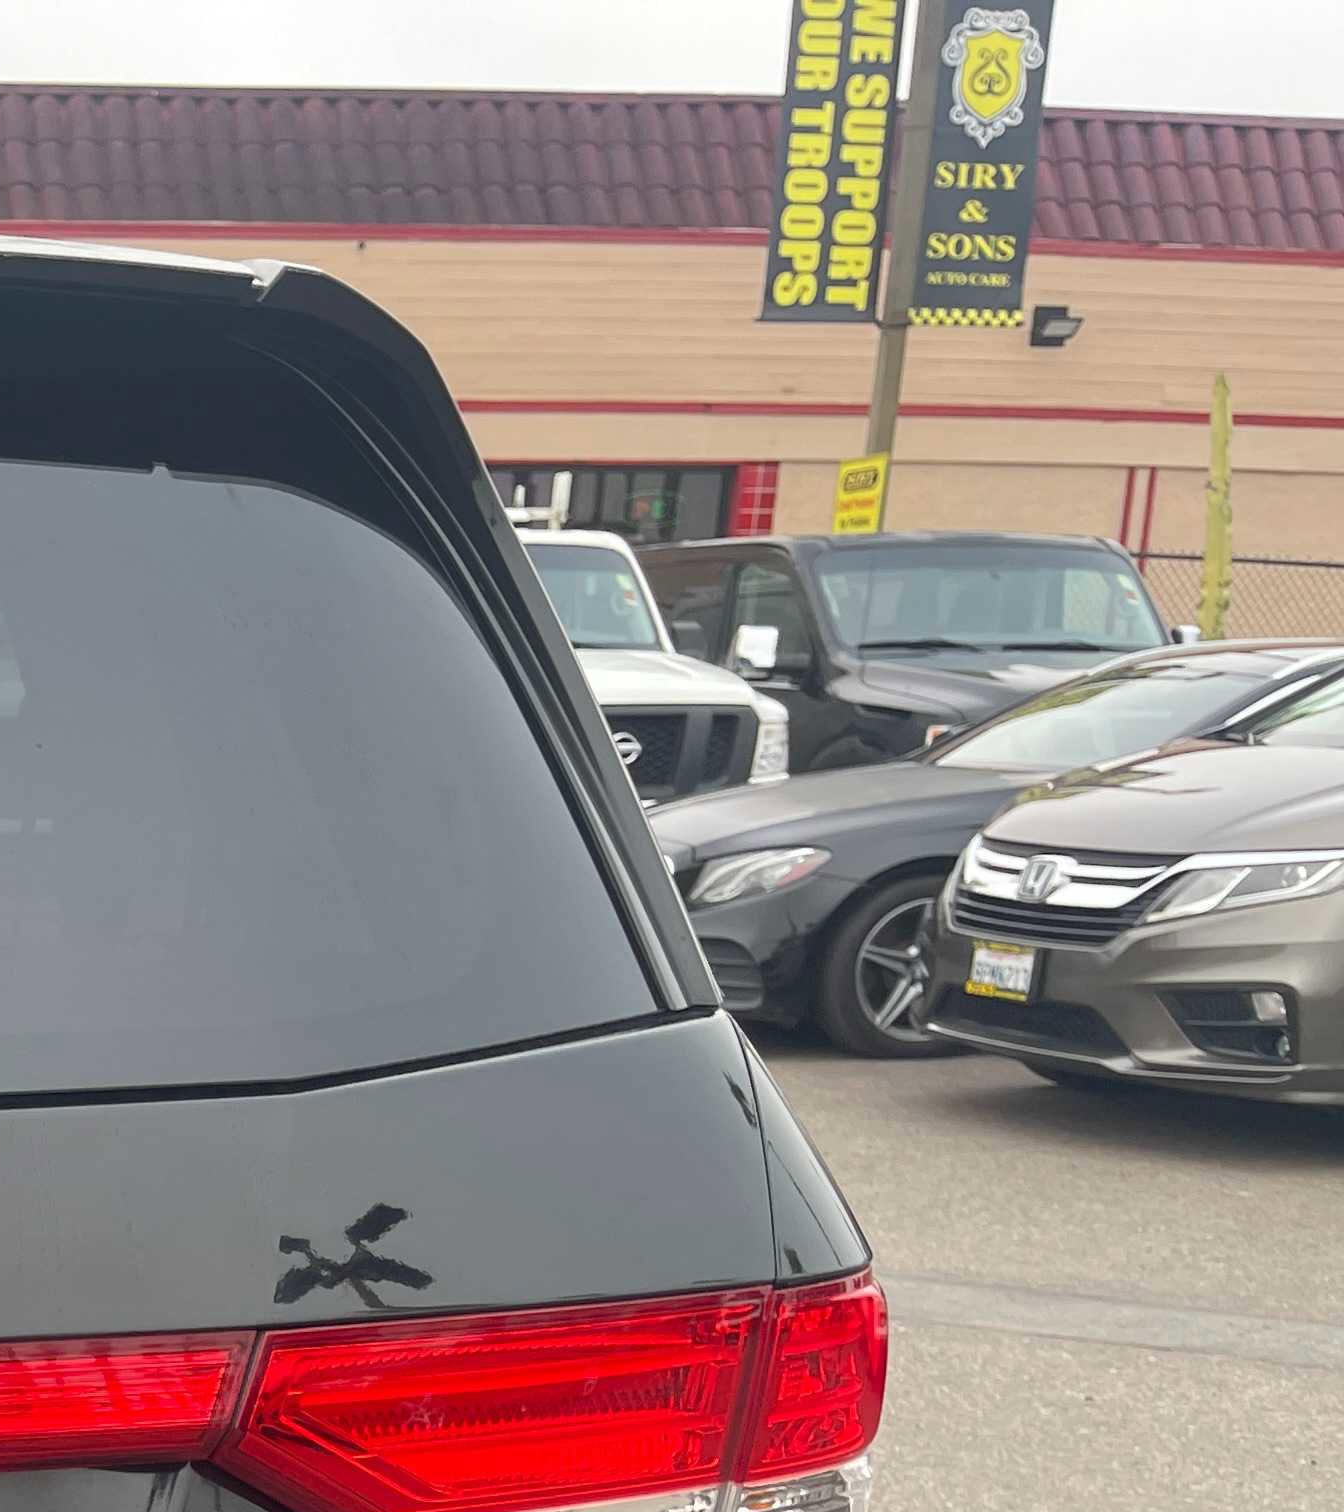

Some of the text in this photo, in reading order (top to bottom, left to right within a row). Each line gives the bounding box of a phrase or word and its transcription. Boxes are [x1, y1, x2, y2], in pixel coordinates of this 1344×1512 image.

[772, 0, 846, 306] OUR TROOPS
[824, 0, 897, 311] WE SUPPORT
[934, 160, 1025, 191] SIRY
[958, 199, 989, 223] &
[926, 232, 1017, 262] SONS
[926, 271, 1011, 288] AUTO CARE
